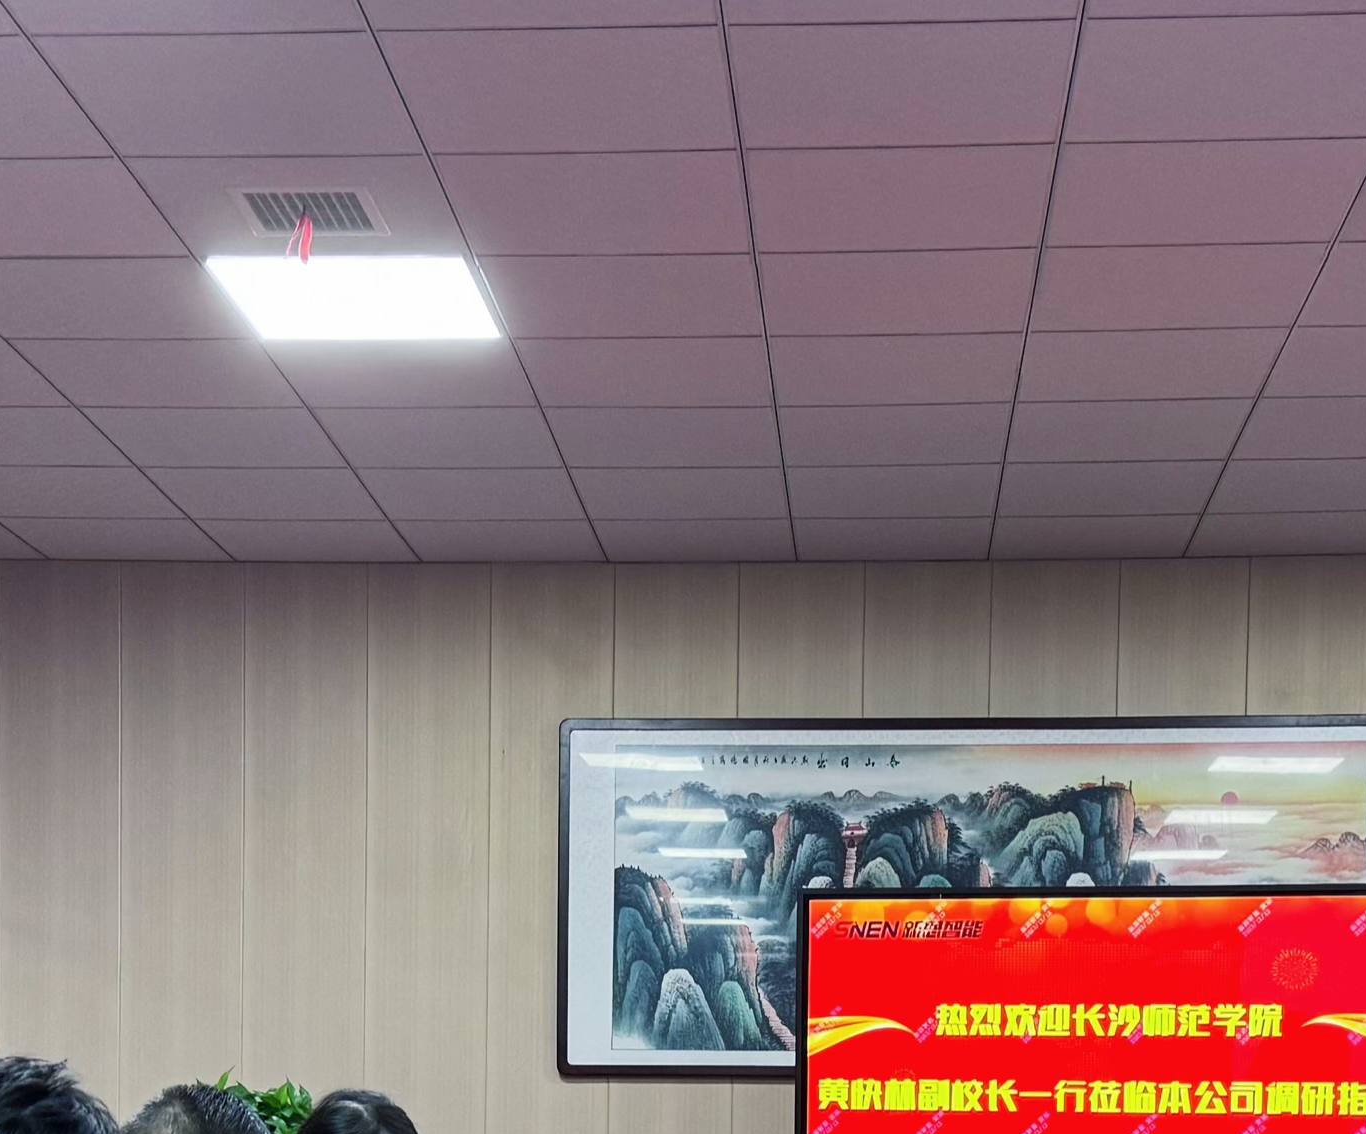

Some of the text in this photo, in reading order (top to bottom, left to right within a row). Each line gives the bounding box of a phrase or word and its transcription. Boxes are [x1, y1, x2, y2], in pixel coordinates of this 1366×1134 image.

[834, 920, 900, 938] SNEN
[934, 1002, 1284, 1038] 热烈欢迎长沙师范学院
